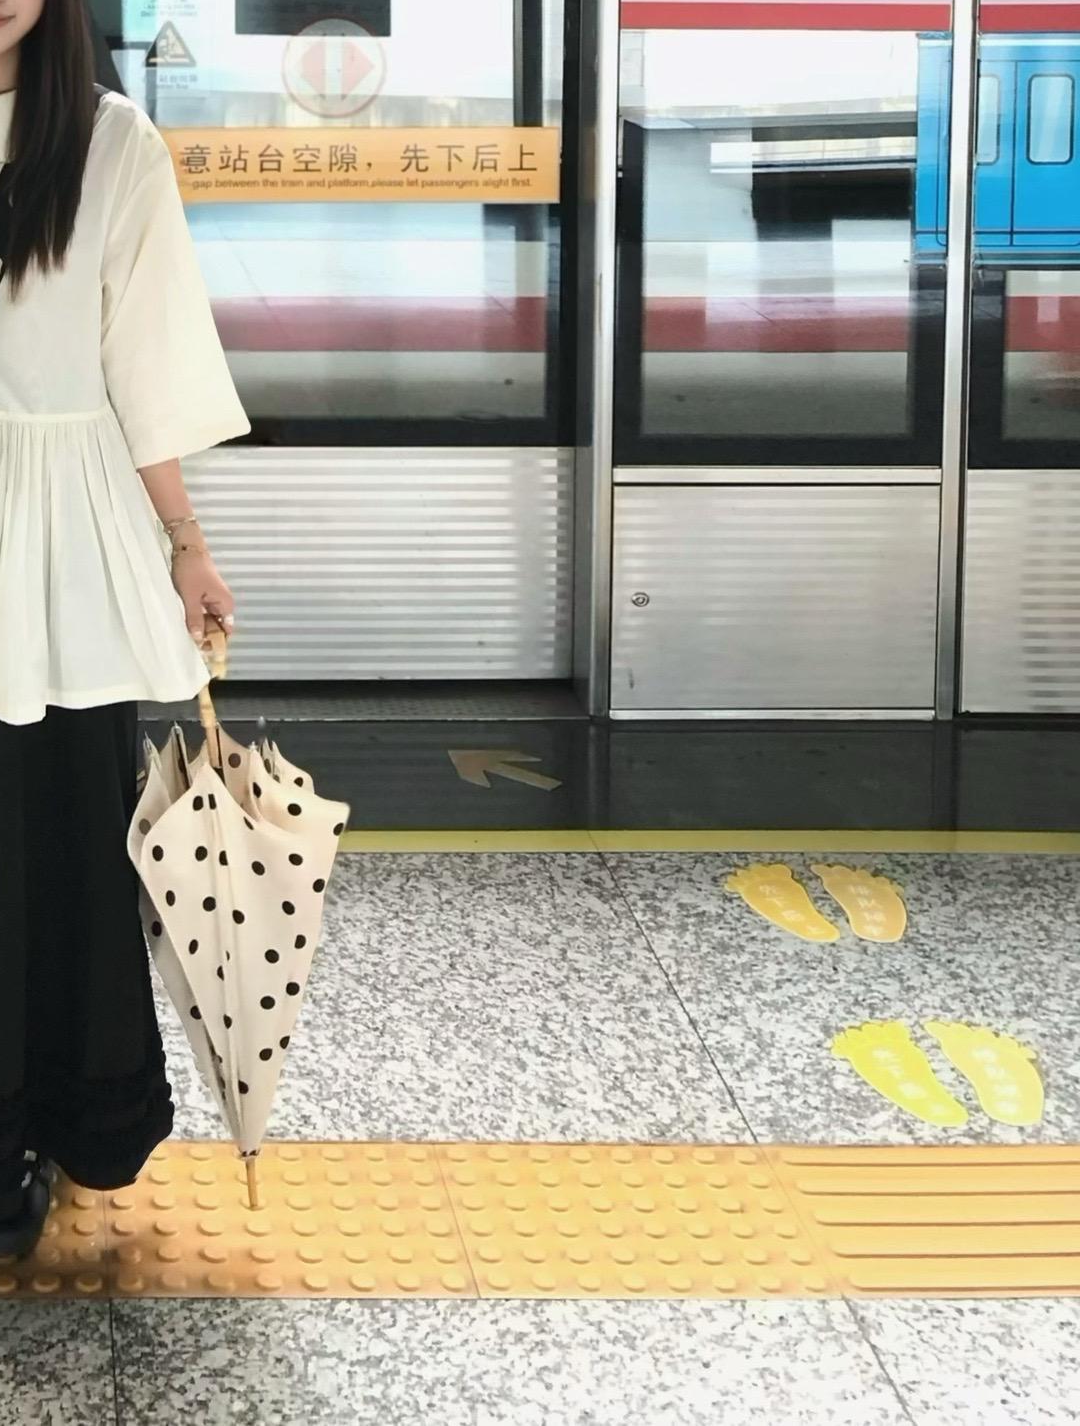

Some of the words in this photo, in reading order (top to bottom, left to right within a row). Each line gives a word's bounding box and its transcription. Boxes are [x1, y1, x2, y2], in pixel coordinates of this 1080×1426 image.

[192, 178, 212, 190] gap
[215, 177, 260, 188] between
[262, 177, 278, 187] the
[281, 177, 303, 187] train
[307, 177, 325, 187] and
[406, 176, 419, 187] let
[421, 178, 479, 189] passengers
[482, 177, 509, 189] alight
